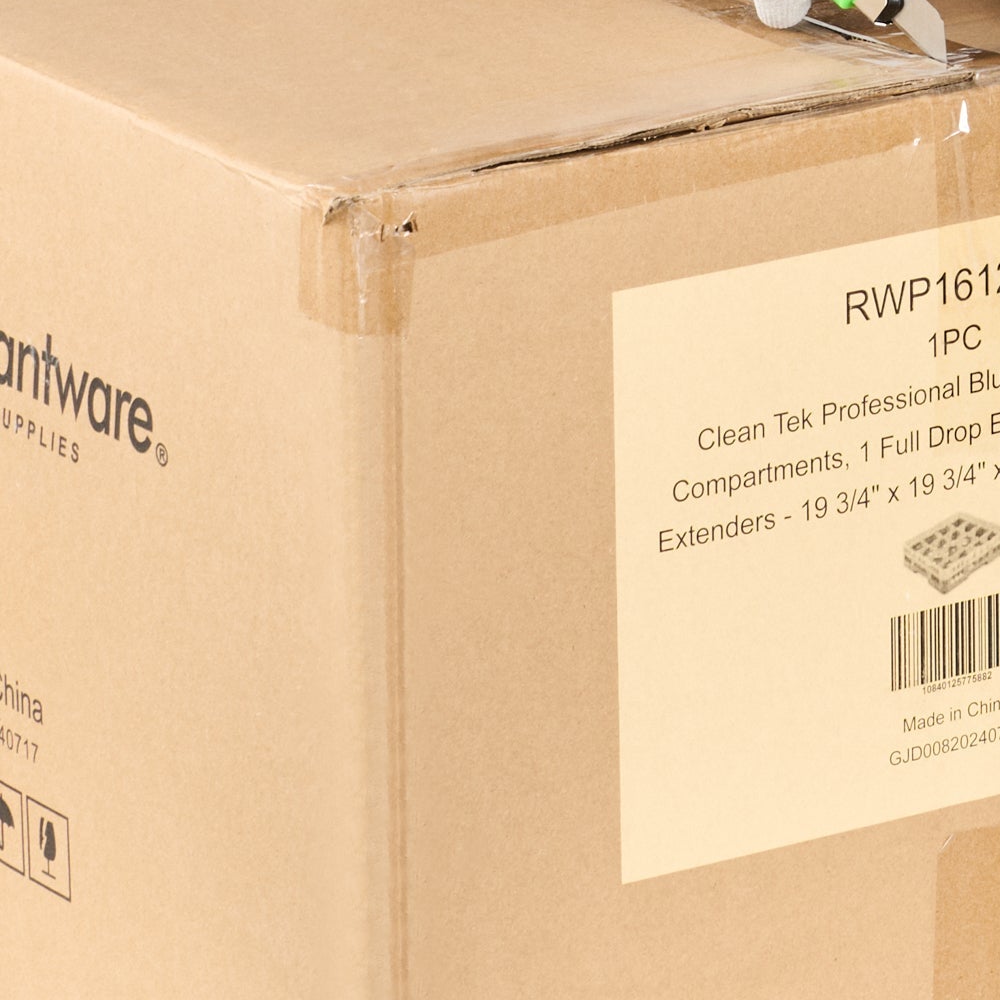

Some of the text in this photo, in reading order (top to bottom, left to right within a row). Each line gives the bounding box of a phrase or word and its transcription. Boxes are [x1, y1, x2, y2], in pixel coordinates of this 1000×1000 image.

[929, 324, 981, 358] 1PC
[698, 423, 765, 450] Clean
[773, 408, 813, 434] Tek
[823, 375, 960, 425] Professional
[673, 450, 849, 502] Compartments,
[861, 441, 868, 462] 1
[881, 430, 919, 459] Full
[929, 423, 981, 448] Drop
[659, 513, 775, 553] Extenders
[802, 496, 827, 521] 19
[837, 484, 880, 514] 3/4"
[888, 486, 899, 503] x
[909, 473, 934, 498] 19
[943, 461, 986, 490] 3/4"
[922, 671, 992, 695] 10840125775882
[903, 712, 945, 733] Made
[950, 707, 962, 721] in
